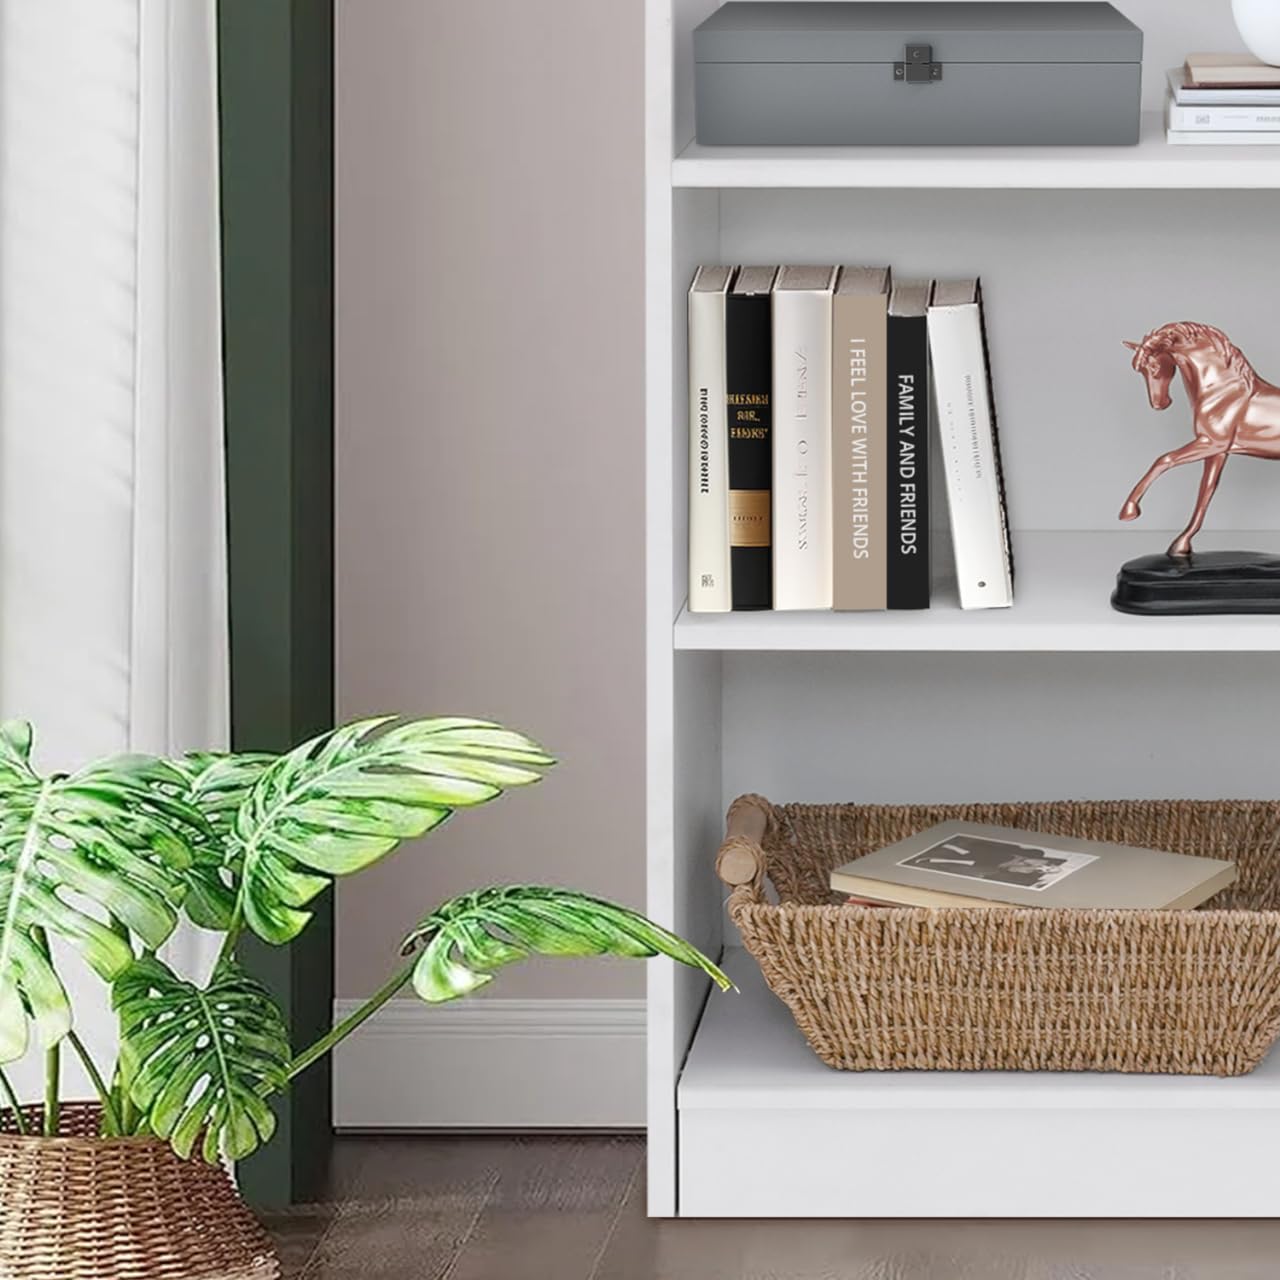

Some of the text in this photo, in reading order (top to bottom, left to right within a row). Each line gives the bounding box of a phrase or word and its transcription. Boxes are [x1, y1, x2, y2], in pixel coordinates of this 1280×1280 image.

[850, 349, 867, 387] FEEL
[850, 391, 867, 434] LOVE
[851, 437, 868, 483] WITH
[898, 374, 917, 555] FAMILY AND FRIENDS
[852, 487, 869, 559] FRIENDS
